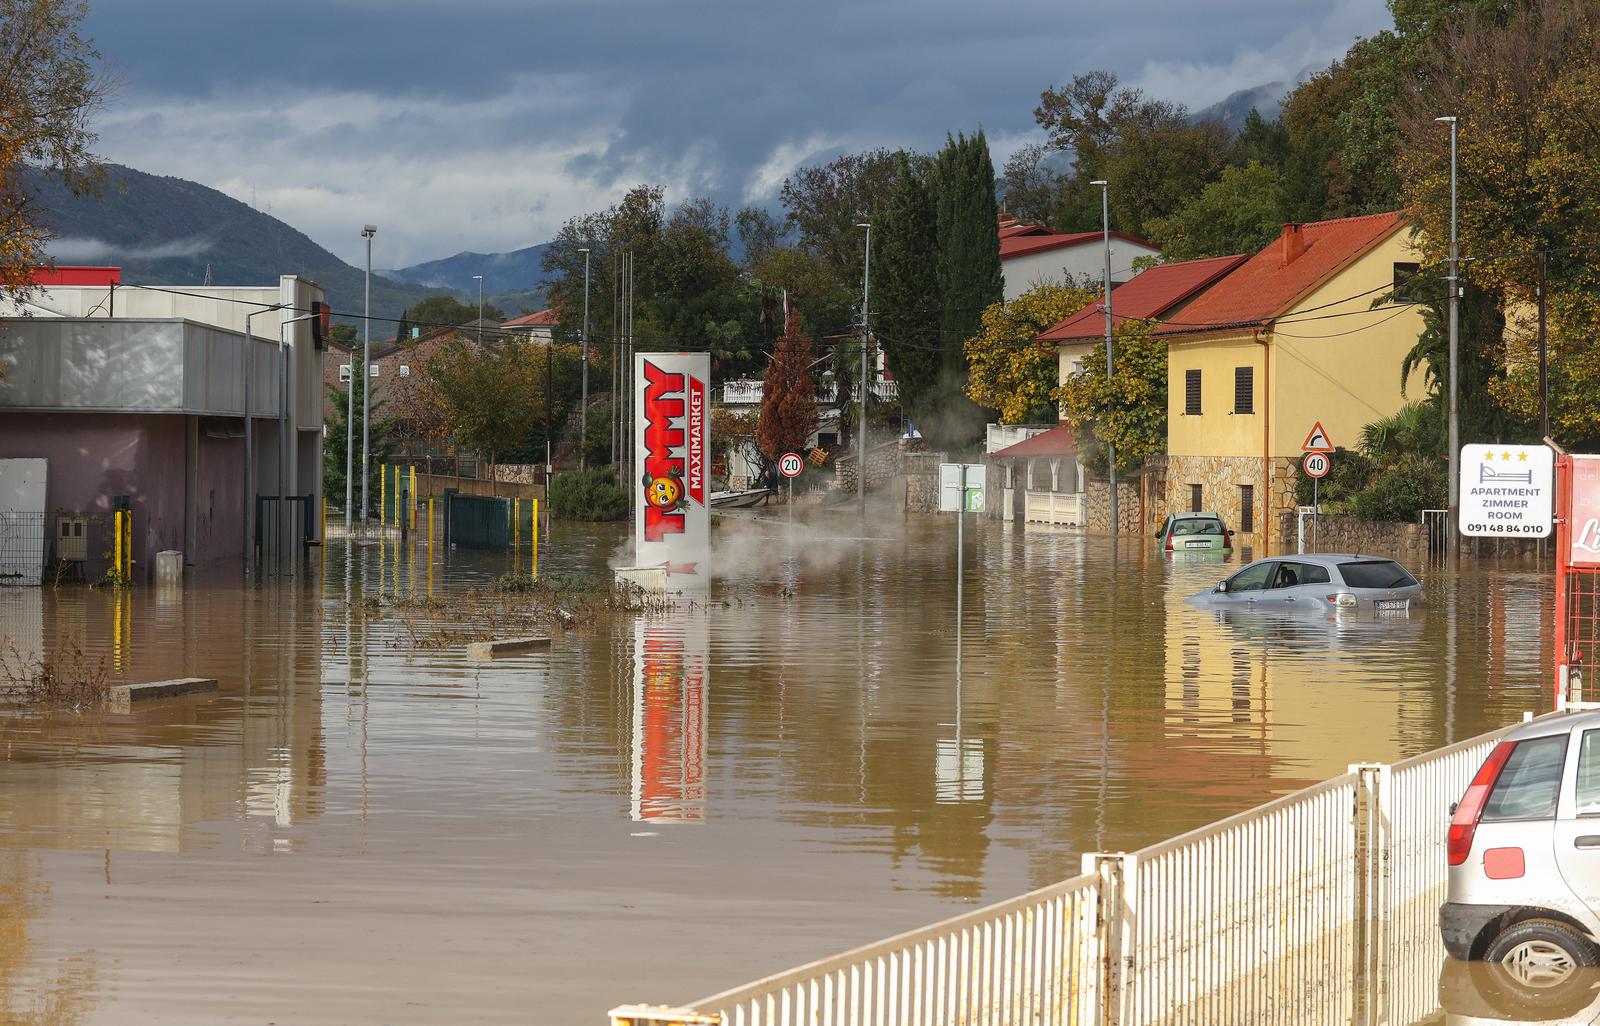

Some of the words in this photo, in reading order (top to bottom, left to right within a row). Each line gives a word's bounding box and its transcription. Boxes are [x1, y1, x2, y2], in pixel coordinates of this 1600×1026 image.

[691, 389, 702, 489] MAXIMARKET
[644, 358, 685, 542] TOMMY
[784, 459, 798, 471] 20
[1309, 459, 1324, 470] 40
[1470, 487, 1541, 496] APARTMENT
[1482, 499, 1529, 508] ZIMMER
[1487, 511, 1523, 520] ROOM
[1467, 523, 1487, 532] 091
[1489, 524, 1504, 533] 48
[1506, 524, 1520, 533] 84
[1522, 525, 1544, 533] 010
